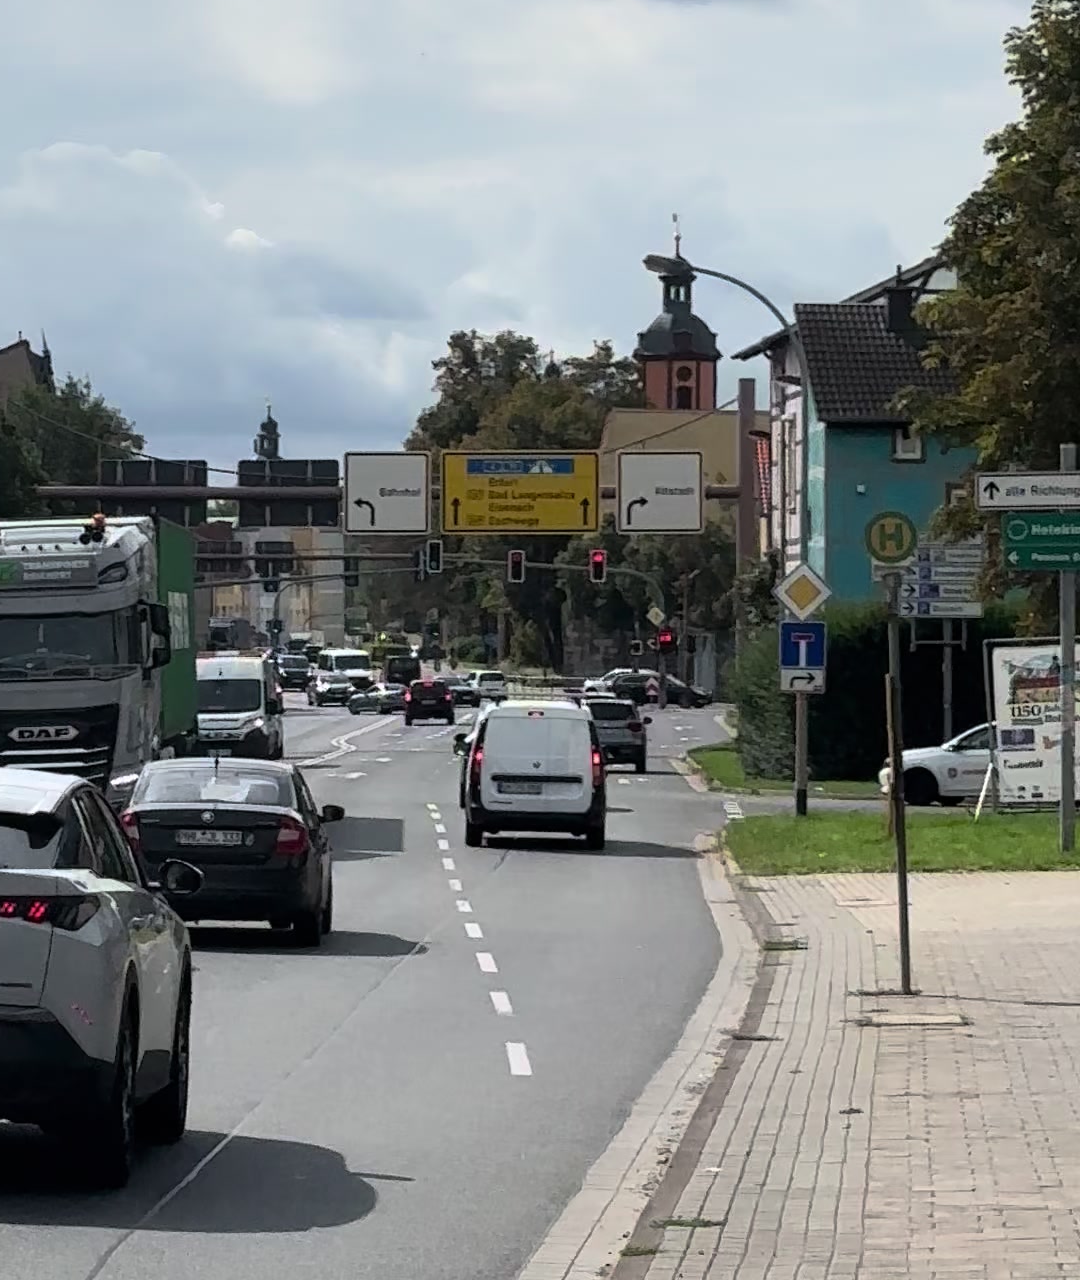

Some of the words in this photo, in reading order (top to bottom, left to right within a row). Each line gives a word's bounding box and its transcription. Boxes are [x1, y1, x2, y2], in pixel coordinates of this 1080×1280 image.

[1030, 485, 1080, 498] Richtung
[878, 523, 904, 553] H
[18, 728, 70, 739] DAF
